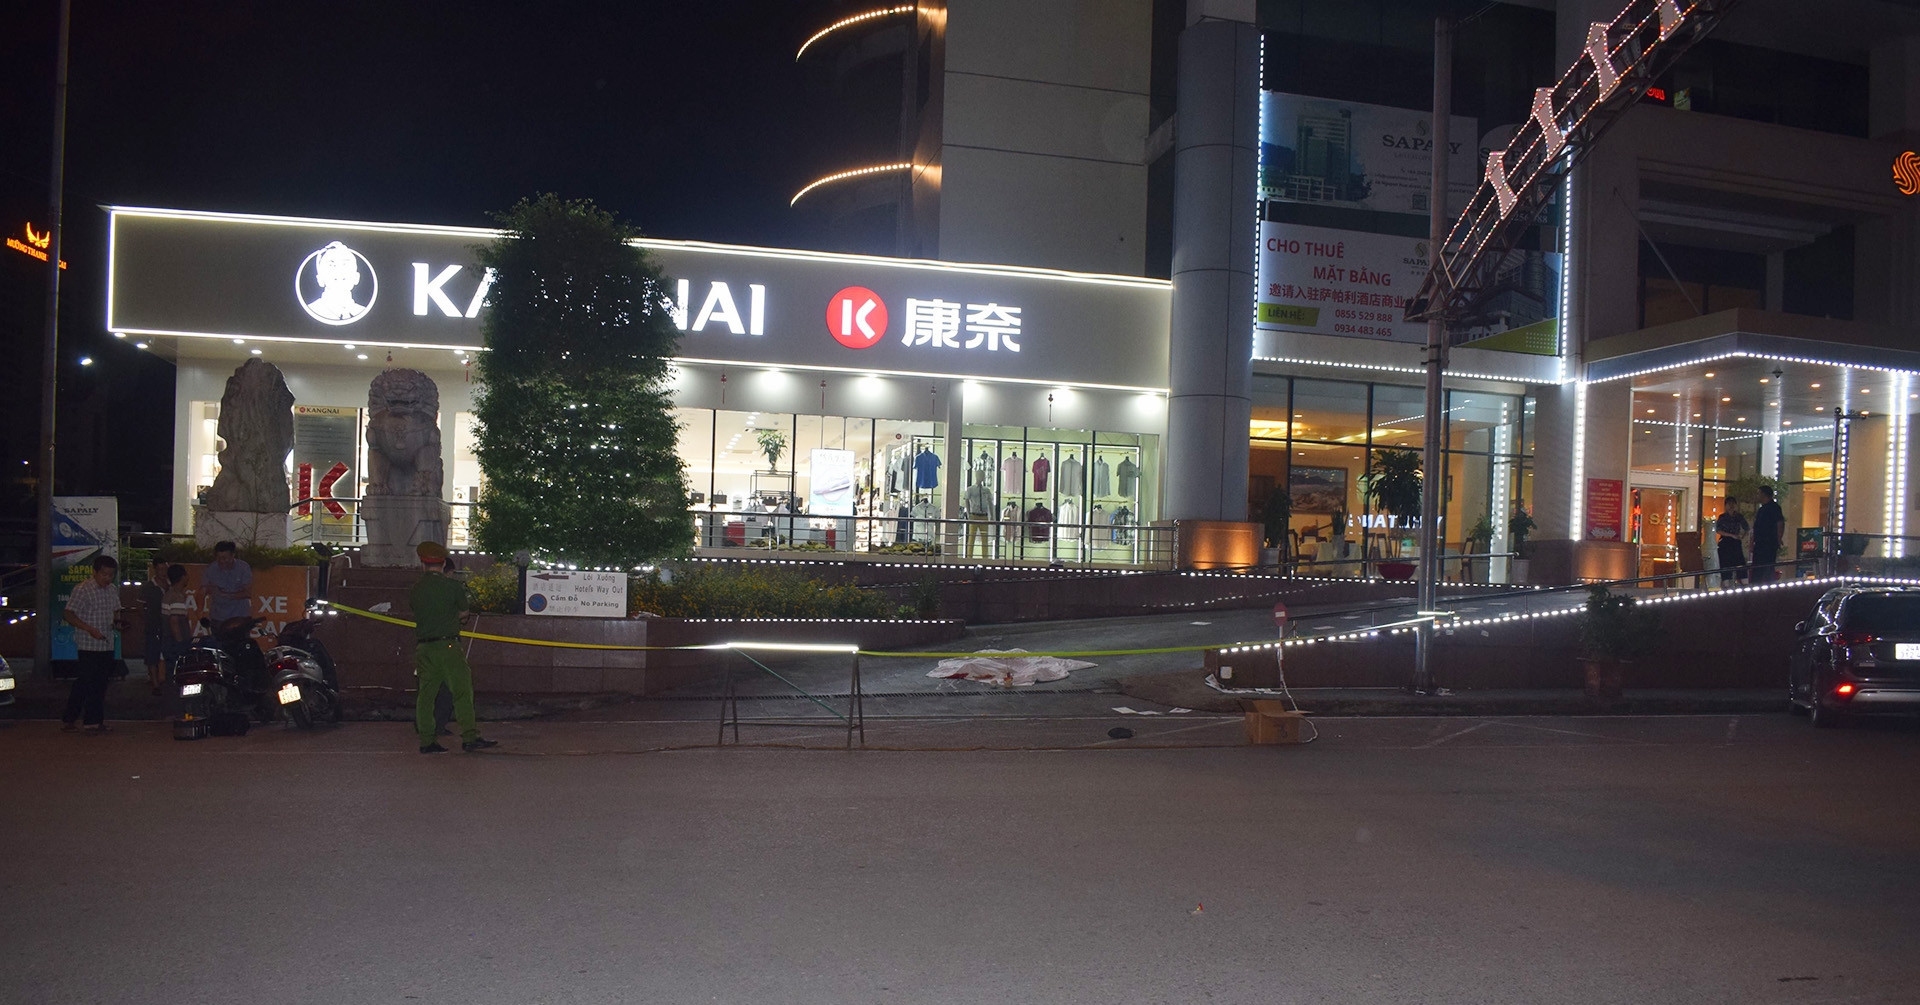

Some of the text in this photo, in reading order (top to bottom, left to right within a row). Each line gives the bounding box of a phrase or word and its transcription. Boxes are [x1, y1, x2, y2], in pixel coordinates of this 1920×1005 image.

[1382, 135, 1462, 154] SAPAY
[1267, 238, 1344, 259] CHO THUÊ
[1313, 265, 1391, 287] MẶT BẰNG
[1269, 283, 1412, 309] 邀请入驻萨帕利酒店商业
[901, 297, 1022, 353] 康奈
[1335, 309, 1393, 323] 0855 529 888
[1334, 323, 1392, 337] 0934 483 465
[306, 407, 340, 415] KANGNAI
[596, 586, 609, 595] Way
[612, 586, 623, 594] Out
[258, 596, 288, 614] XE
[592, 601, 619, 609] Parking
